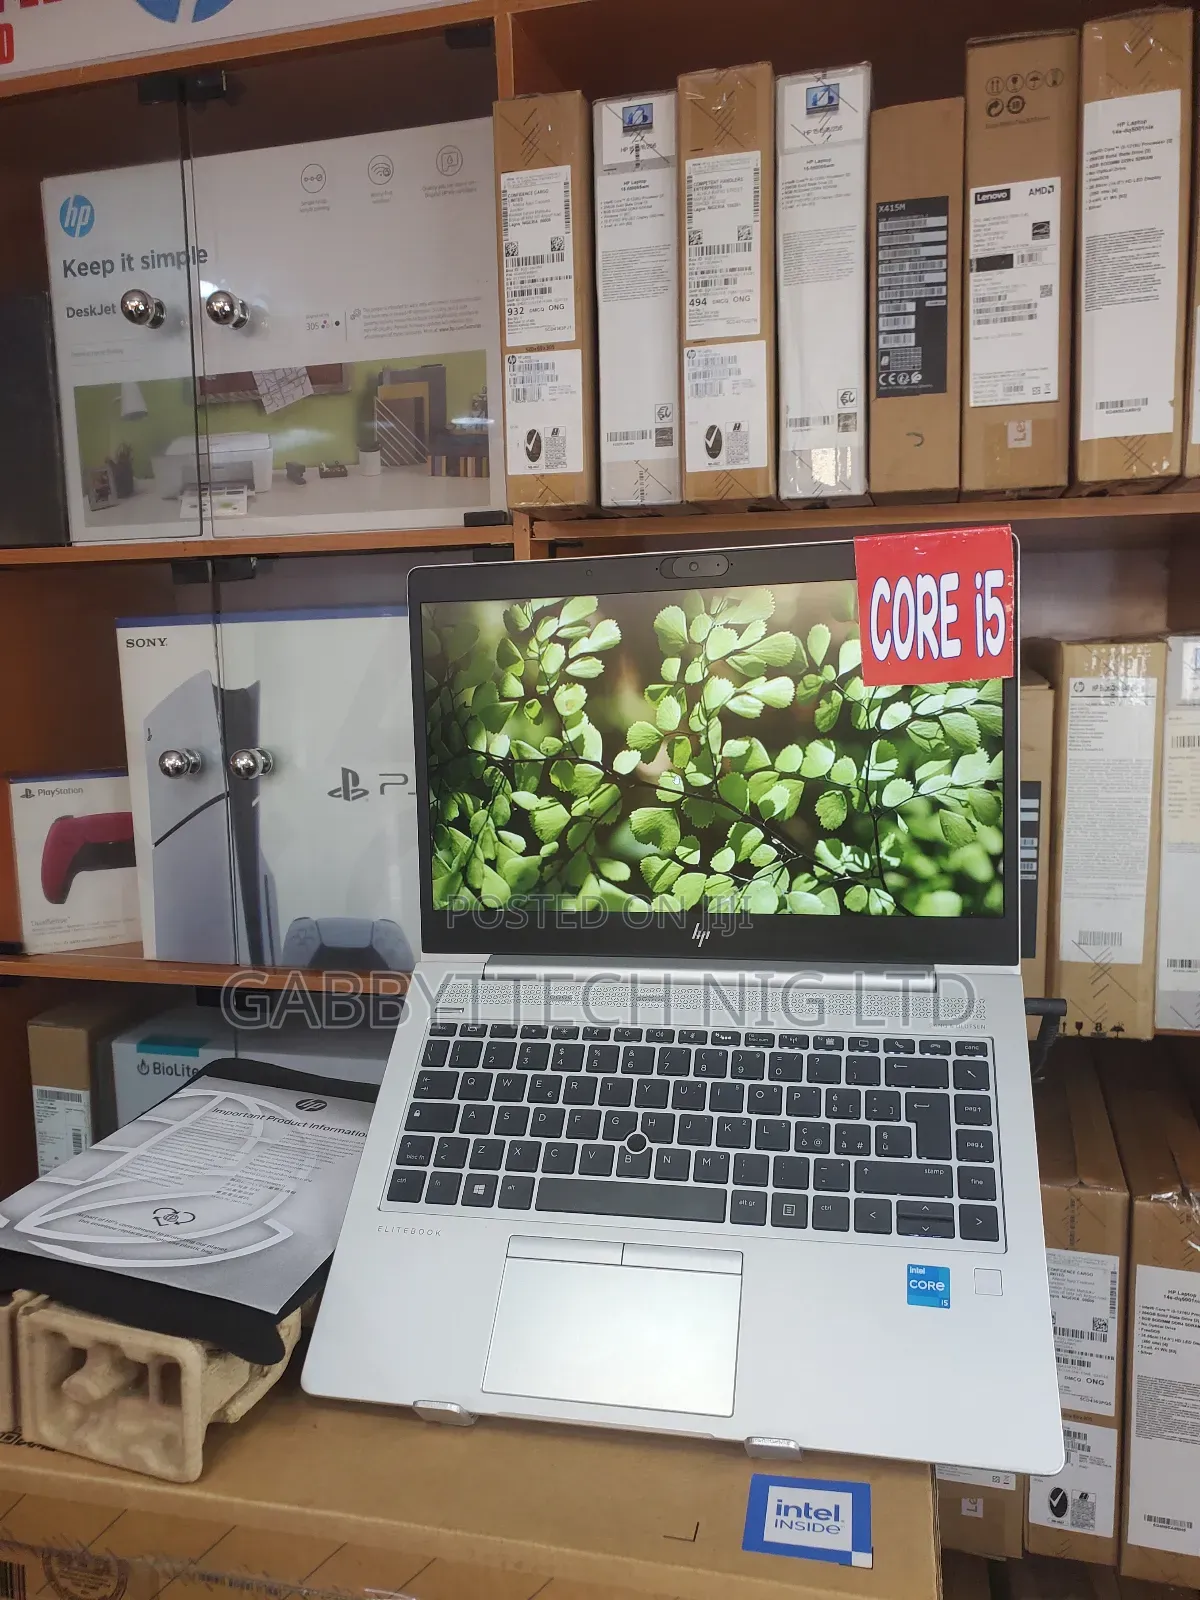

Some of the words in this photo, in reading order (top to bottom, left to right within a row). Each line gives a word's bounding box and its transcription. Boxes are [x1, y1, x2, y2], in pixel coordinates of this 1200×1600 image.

[976, 192, 1008, 202] Lenovo
[1028, 186, 1048, 196] AMD
[62, 258, 114, 278] Keep
[120, 252, 134, 272] it
[140, 246, 208, 270] simple
[688, 298, 708, 306] 494
[66, 303, 116, 318] DeskJet
[508, 306, 524, 316] 932
[870, 572, 962, 662] CORE
[974, 568, 1006, 658] i5
[126, 638, 168, 648] SONY
[38, 787, 84, 798] PlayStation
[152, 1061, 199, 1078] BioLite
[664, 1062, 670, 1070] 7
[700, 1064, 706, 1072] 8
[738, 1066, 744, 1074] 9
[467, 1078, 475, 1086] Q
[502, 1078, 512, 1086] W
[536, 1080, 542, 1088] E
[571, 1082, 578, 1090] R
[606, 1083, 614, 1091] T
[644, 1084, 652, 1092] Y
[680, 1086, 688, 1094] U
[794, 1092, 800, 1100] P
[212, 1107, 266, 1120] Important
[266, 1115, 308, 1128] Product
[468, 1110, 476, 1120] A
[504, 1112, 510, 1120] S
[538, 1114, 546, 1122] D
[574, 1115, 582, 1124] F
[612, 1116, 620, 1125] G
[648, 1118, 656, 1127] H
[686, 1120, 692, 1129] J
[724, 1124, 732, 1132] K
[763, 1125, 770, 1134] L
[814, 1138, 822, 1146] @
[478, 1146, 486, 1154] Z
[514, 1148, 522, 1156] X
[551, 1149, 558, 1158] C
[588, 1150, 596, 1159] V
[625, 1155, 632, 1164] B
[664, 1156, 671, 1164] N
[702, 1158, 711, 1166] M
[924, 1168, 944, 1176] stamp
[377, 1225, 442, 1236] ELITEBOOK
[1086, 1378, 1104, 1386] ONG
[776, 1499, 840, 1522] intel
